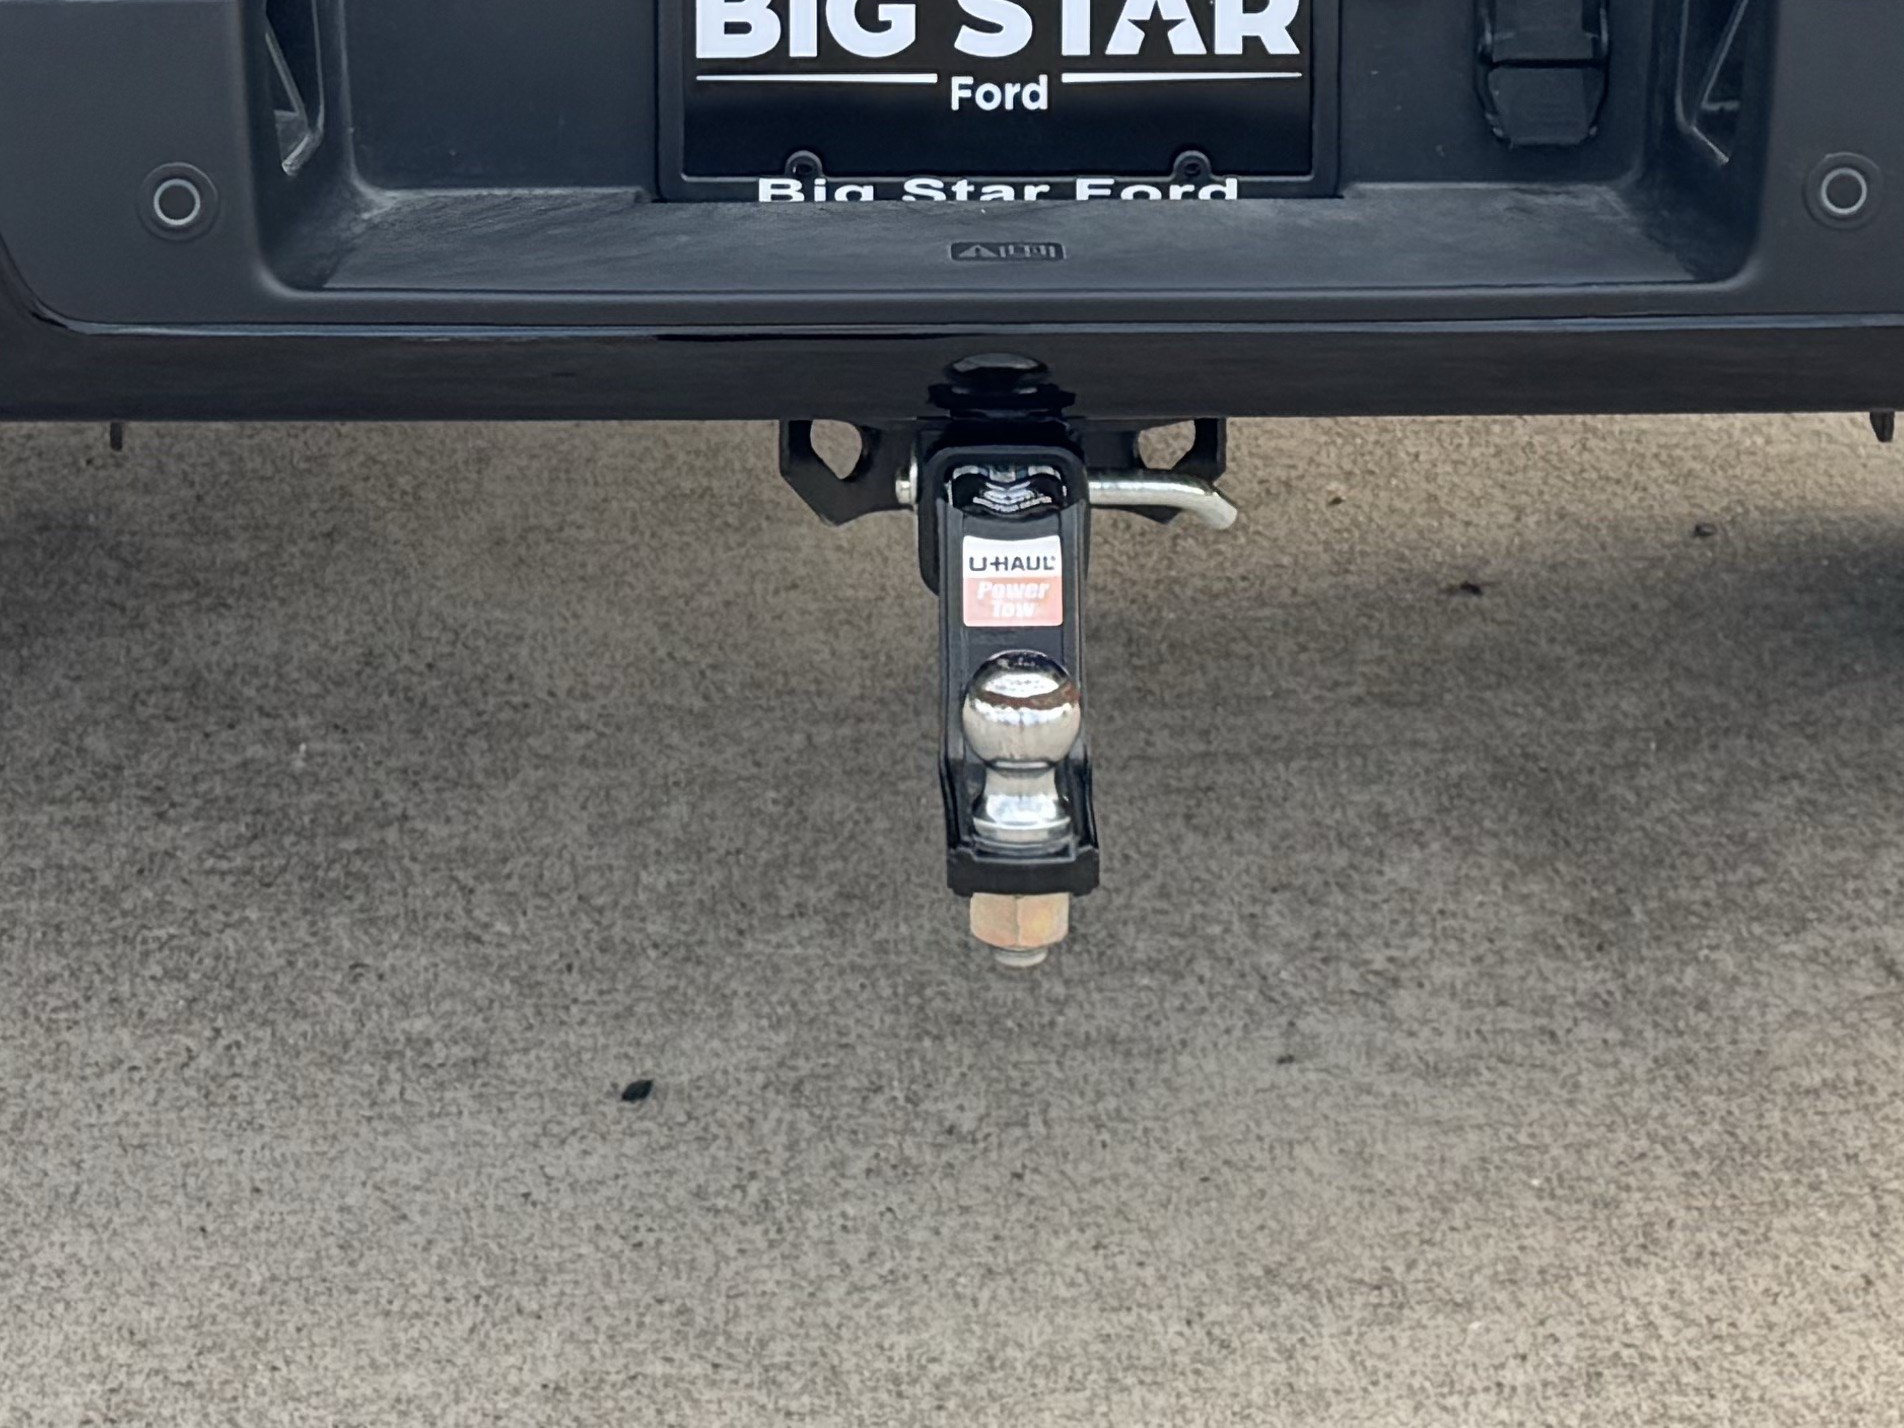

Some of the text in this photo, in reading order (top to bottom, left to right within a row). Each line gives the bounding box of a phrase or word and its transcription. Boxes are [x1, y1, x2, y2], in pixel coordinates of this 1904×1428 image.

[950, 74, 1049, 112] Ford
[901, 176, 1051, 202] Star
[1074, 176, 1239, 202] Ford
[976, 581, 1051, 601] Power
